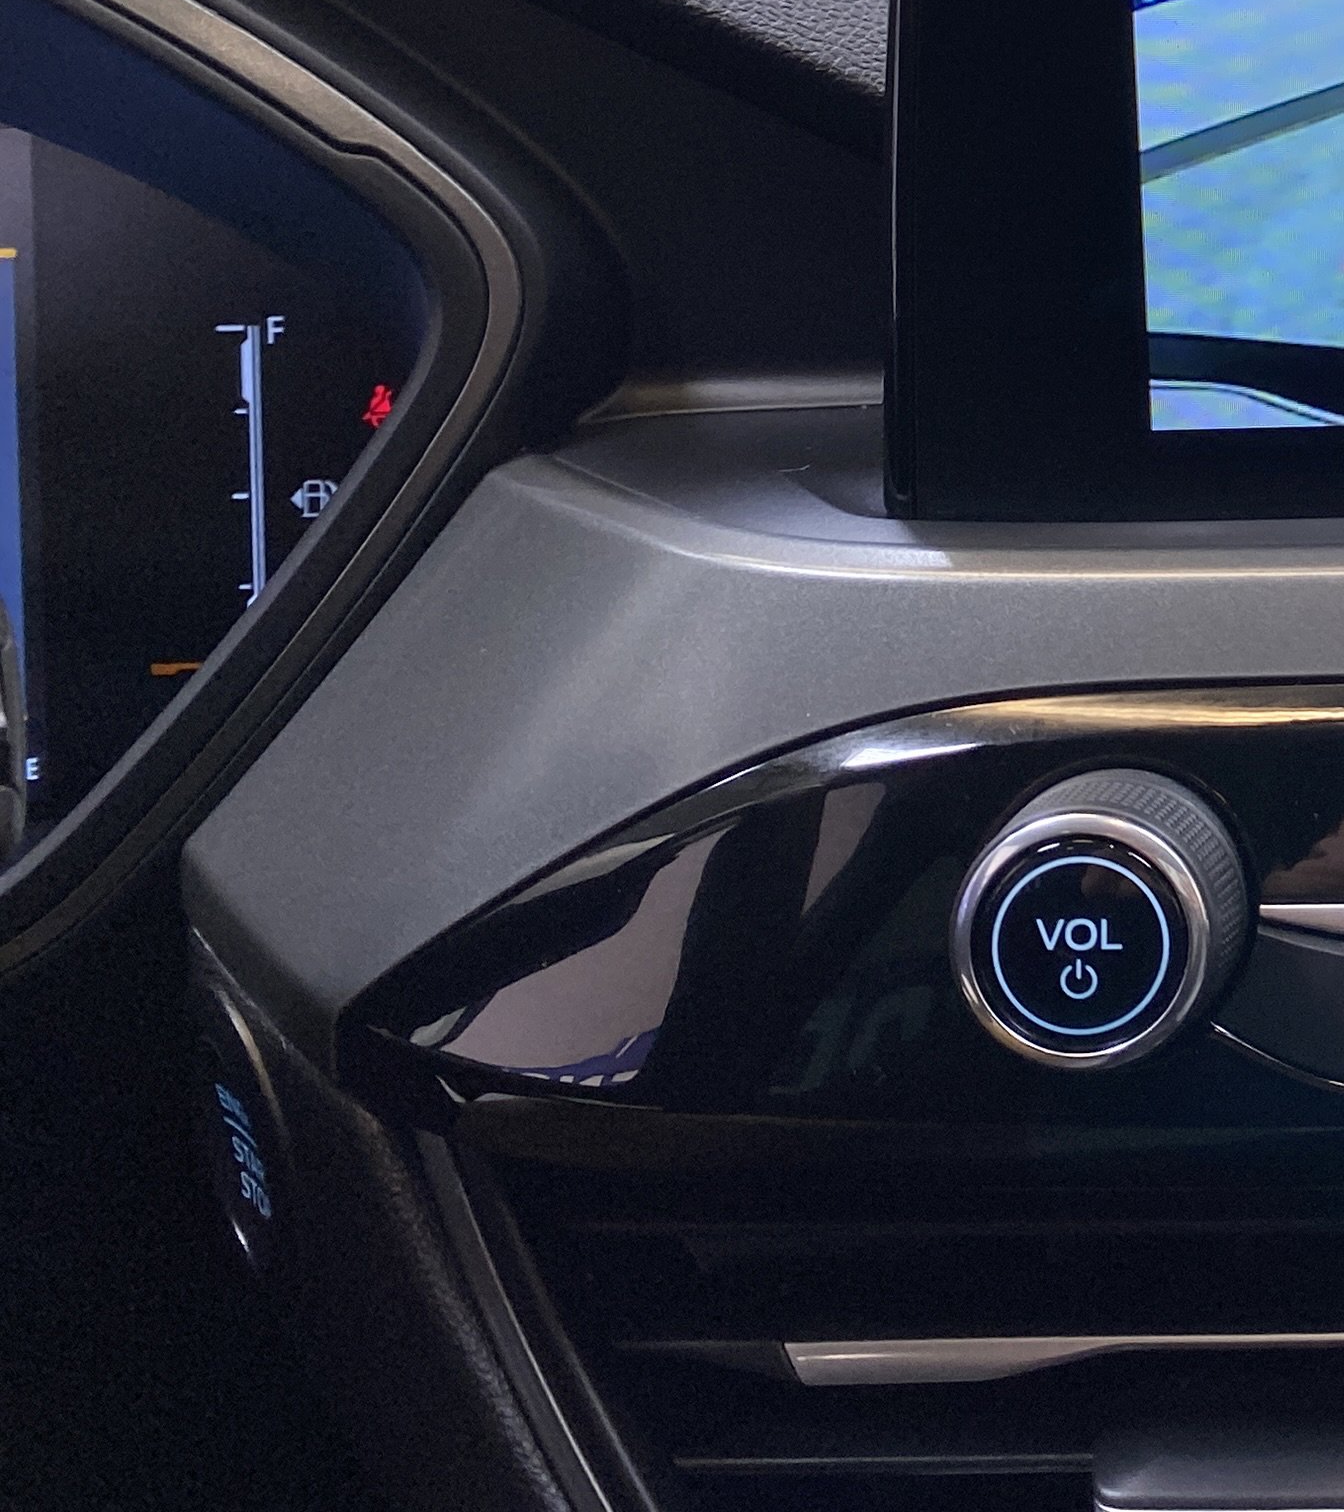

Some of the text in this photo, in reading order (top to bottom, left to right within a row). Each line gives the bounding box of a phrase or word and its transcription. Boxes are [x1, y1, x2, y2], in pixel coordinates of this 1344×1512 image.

[266, 315, 285, 345] F
[25, 757, 40, 781] E
[1035, 917, 1124, 952] VOL
